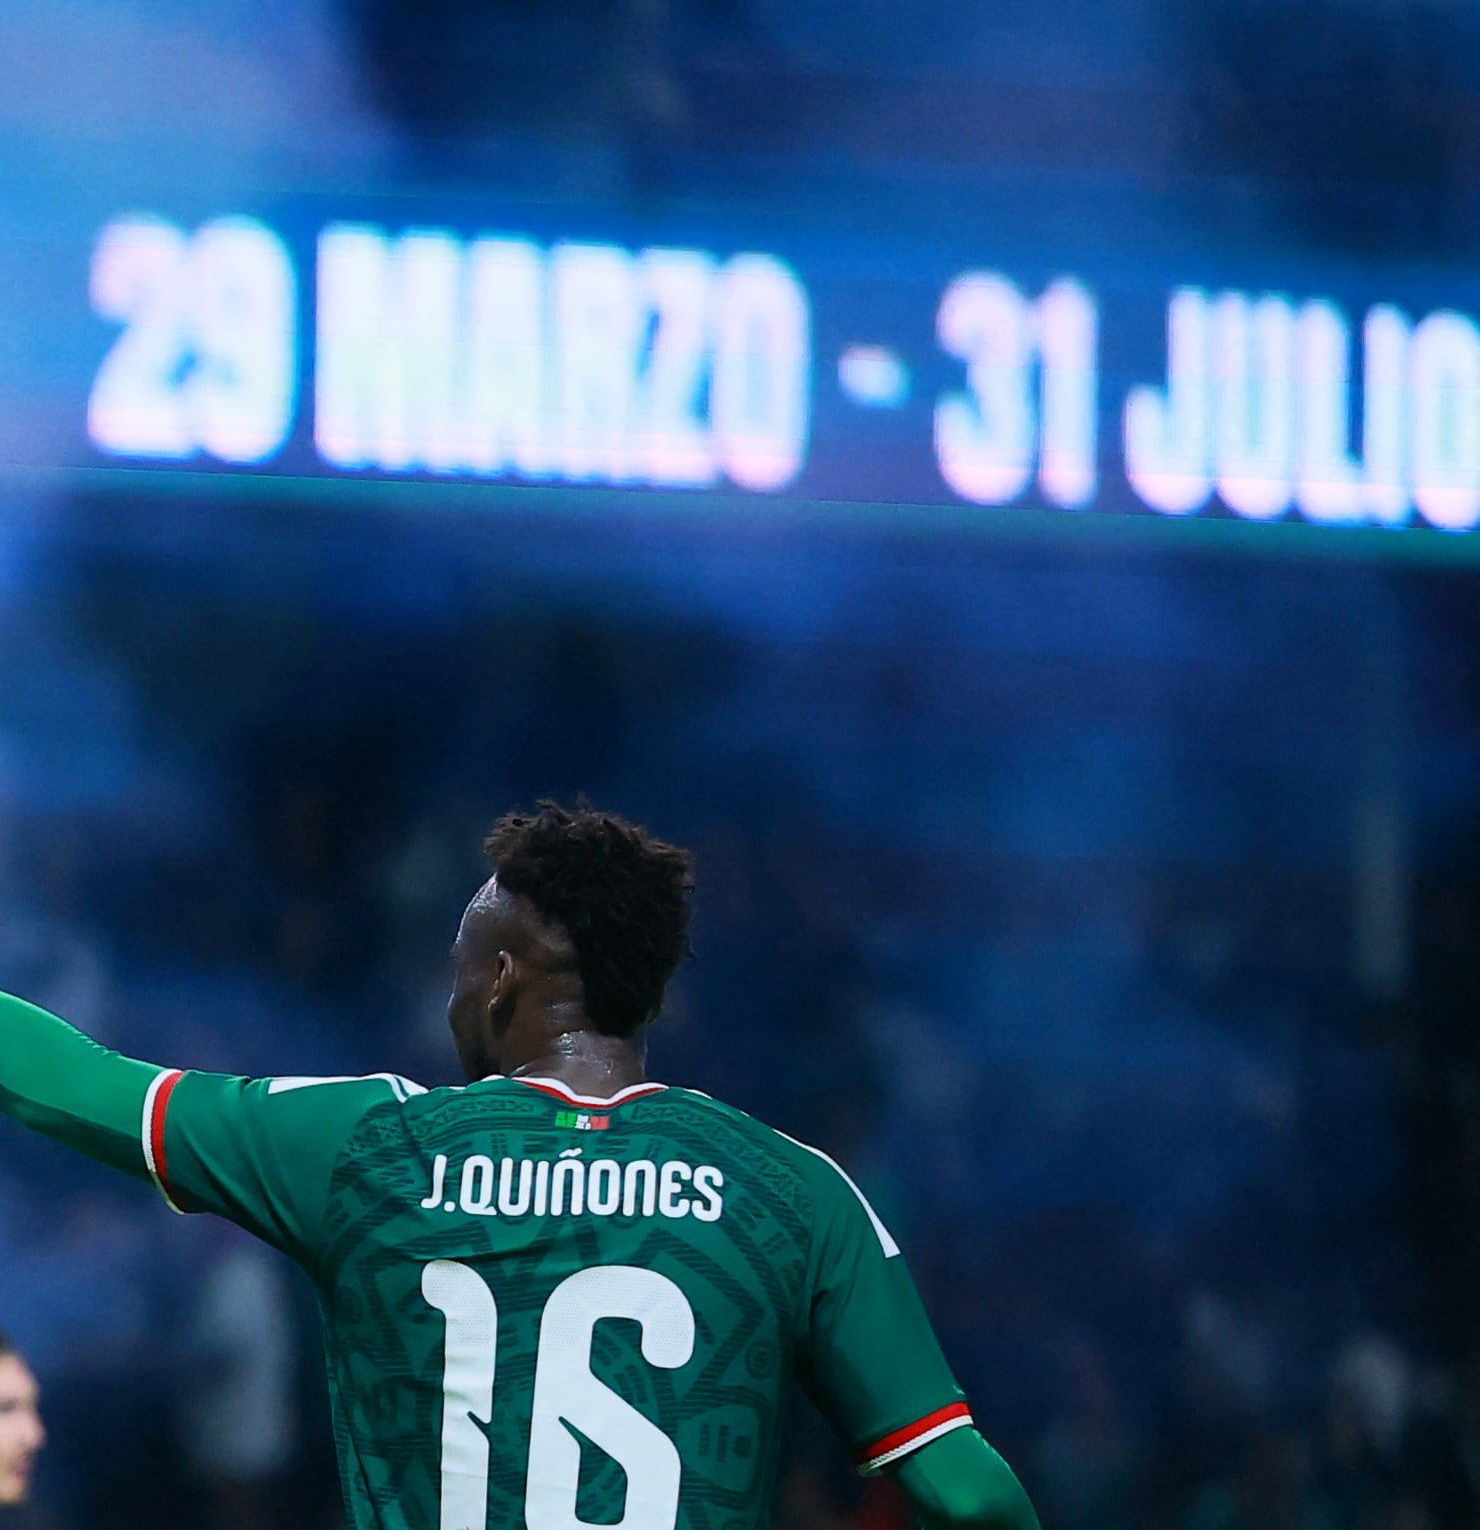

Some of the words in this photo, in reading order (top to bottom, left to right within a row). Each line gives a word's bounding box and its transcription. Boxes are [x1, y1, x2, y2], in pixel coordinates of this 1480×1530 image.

[86, 216, 296, 464] 29
[315, 222, 811, 490] MARZO
[935, 270, 1097, 509] 31
[1125, 284, 1480, 531] JULIO
[421, 1147, 725, 1223] J.QUIÑONES
